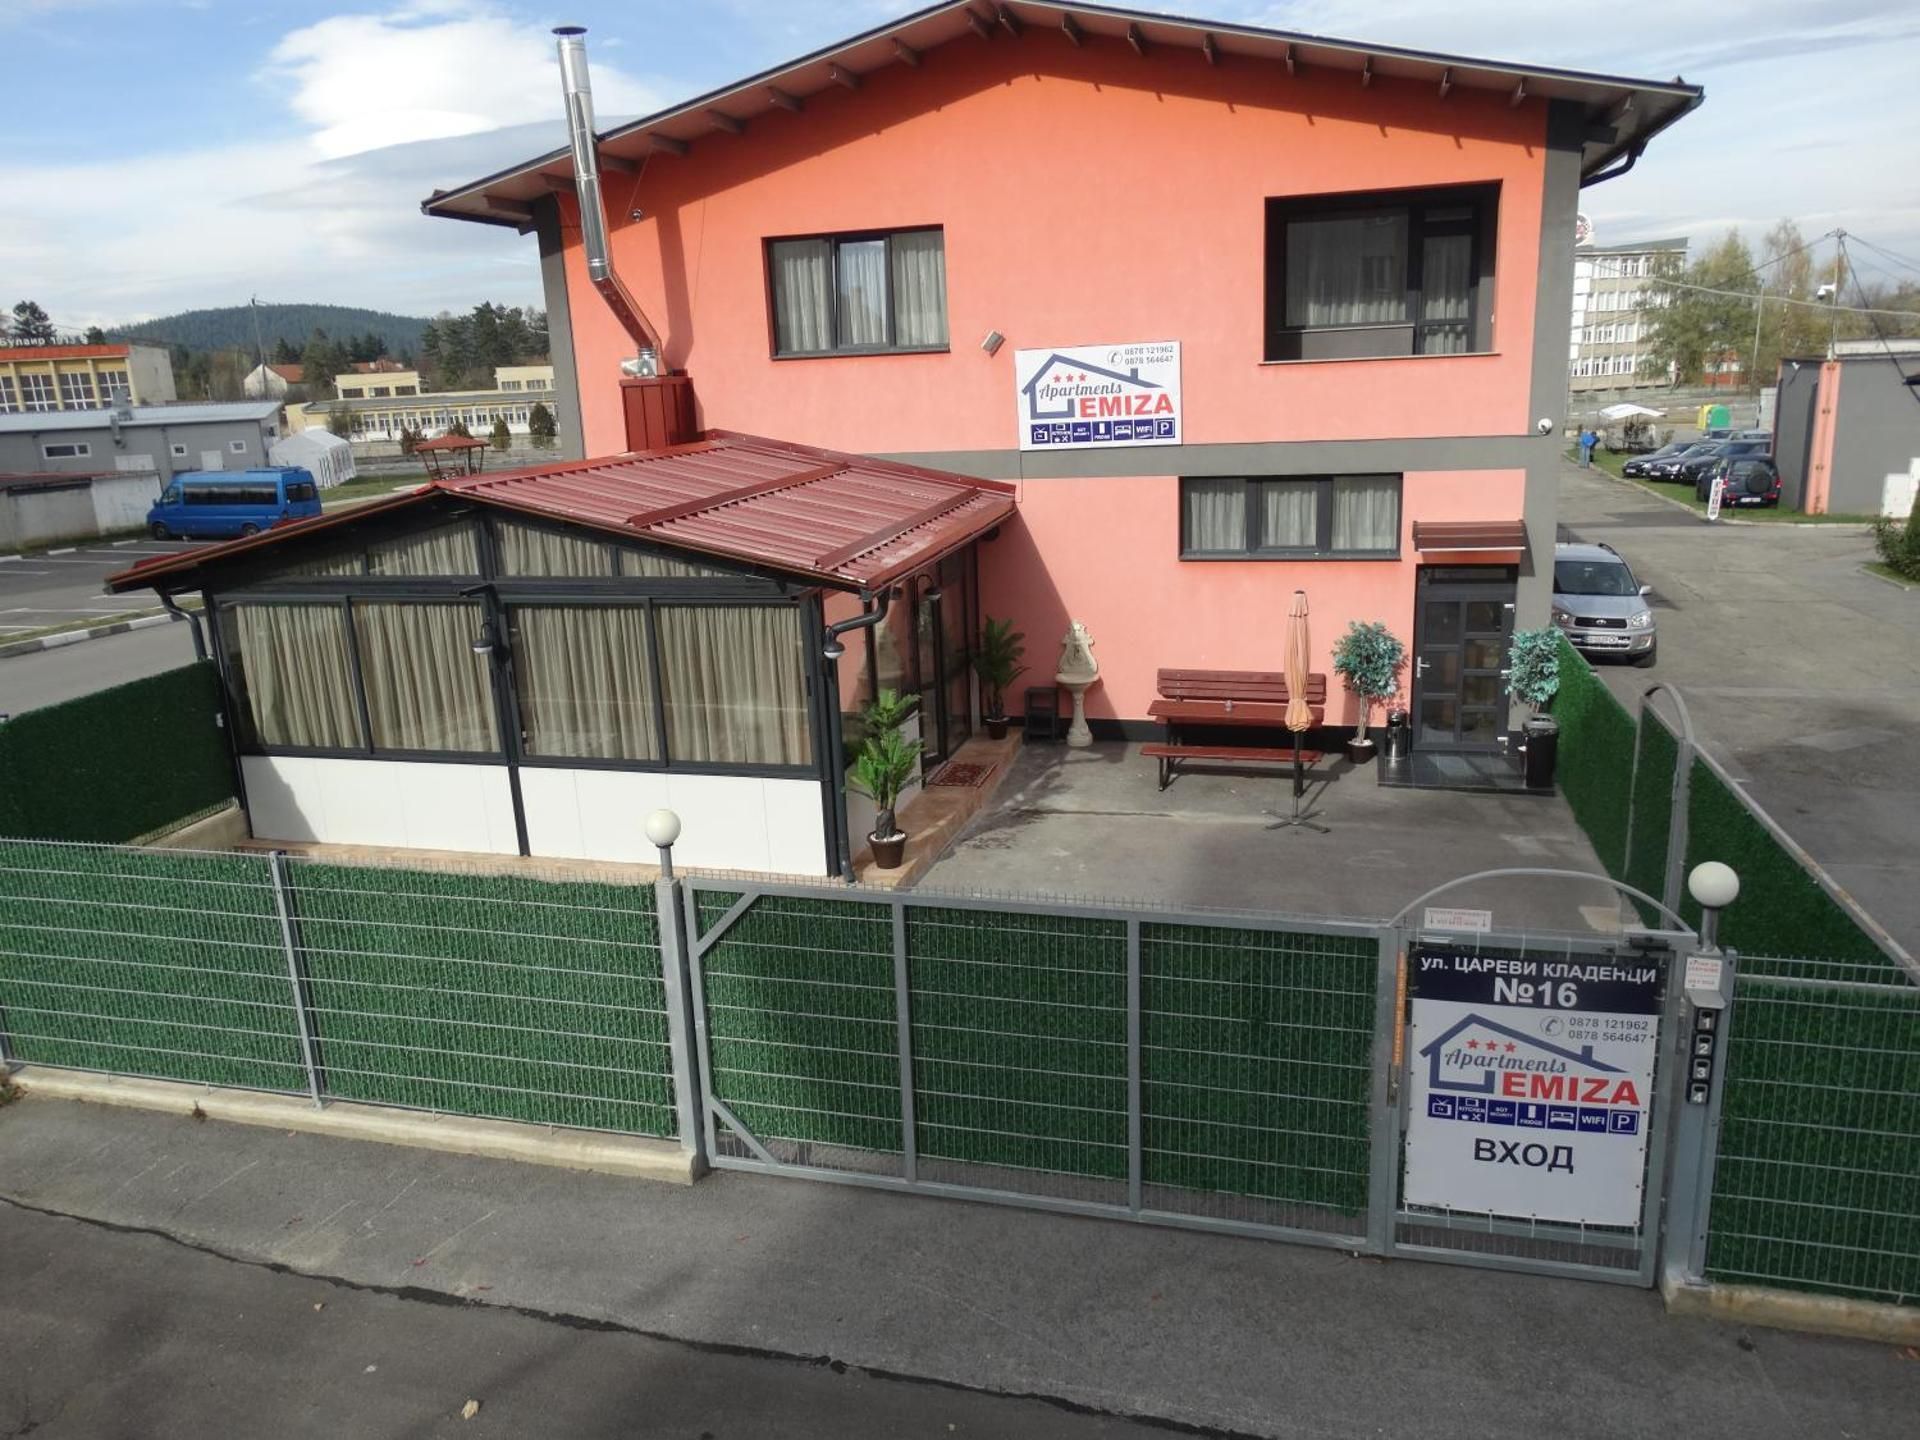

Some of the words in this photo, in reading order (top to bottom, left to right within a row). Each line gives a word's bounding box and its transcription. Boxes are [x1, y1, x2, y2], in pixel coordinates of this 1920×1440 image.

[1124, 347, 1144, 355] 0878
[1124, 356, 1144, 365] 0878
[1039, 382, 1122, 401] Apartments
[1080, 394, 1174, 418] EMIZA
[1160, 422, 1170, 435] P
[1421, 957, 1448, 971] ул.
[1454, 957, 1537, 976] ЦАРЕВИ
[1542, 963, 1656, 984] КЛАДЕНЦИ
[1569, 1018, 1599, 1028] 0878
[1604, 1019, 1649, 1031] 121962
[1703, 1018, 1710, 1029] 1
[1568, 1030, 1599, 1040] 0878
[1602, 1031, 1648, 1043] 564647
[1699, 1043, 1709, 1055] 2
[1444, 1048, 1567, 1073] Apartments
[1697, 1067, 1706, 1078] 3
[1502, 1072, 1641, 1105] EMIZA
[1694, 1091, 1703, 1103] 4
[1520, 1118, 1543, 1126] FRIDGE
[1581, 1115, 1605, 1126] WIFI
[1616, 1114, 1630, 1129] P
[1474, 1138, 1574, 1174] ВХОД
